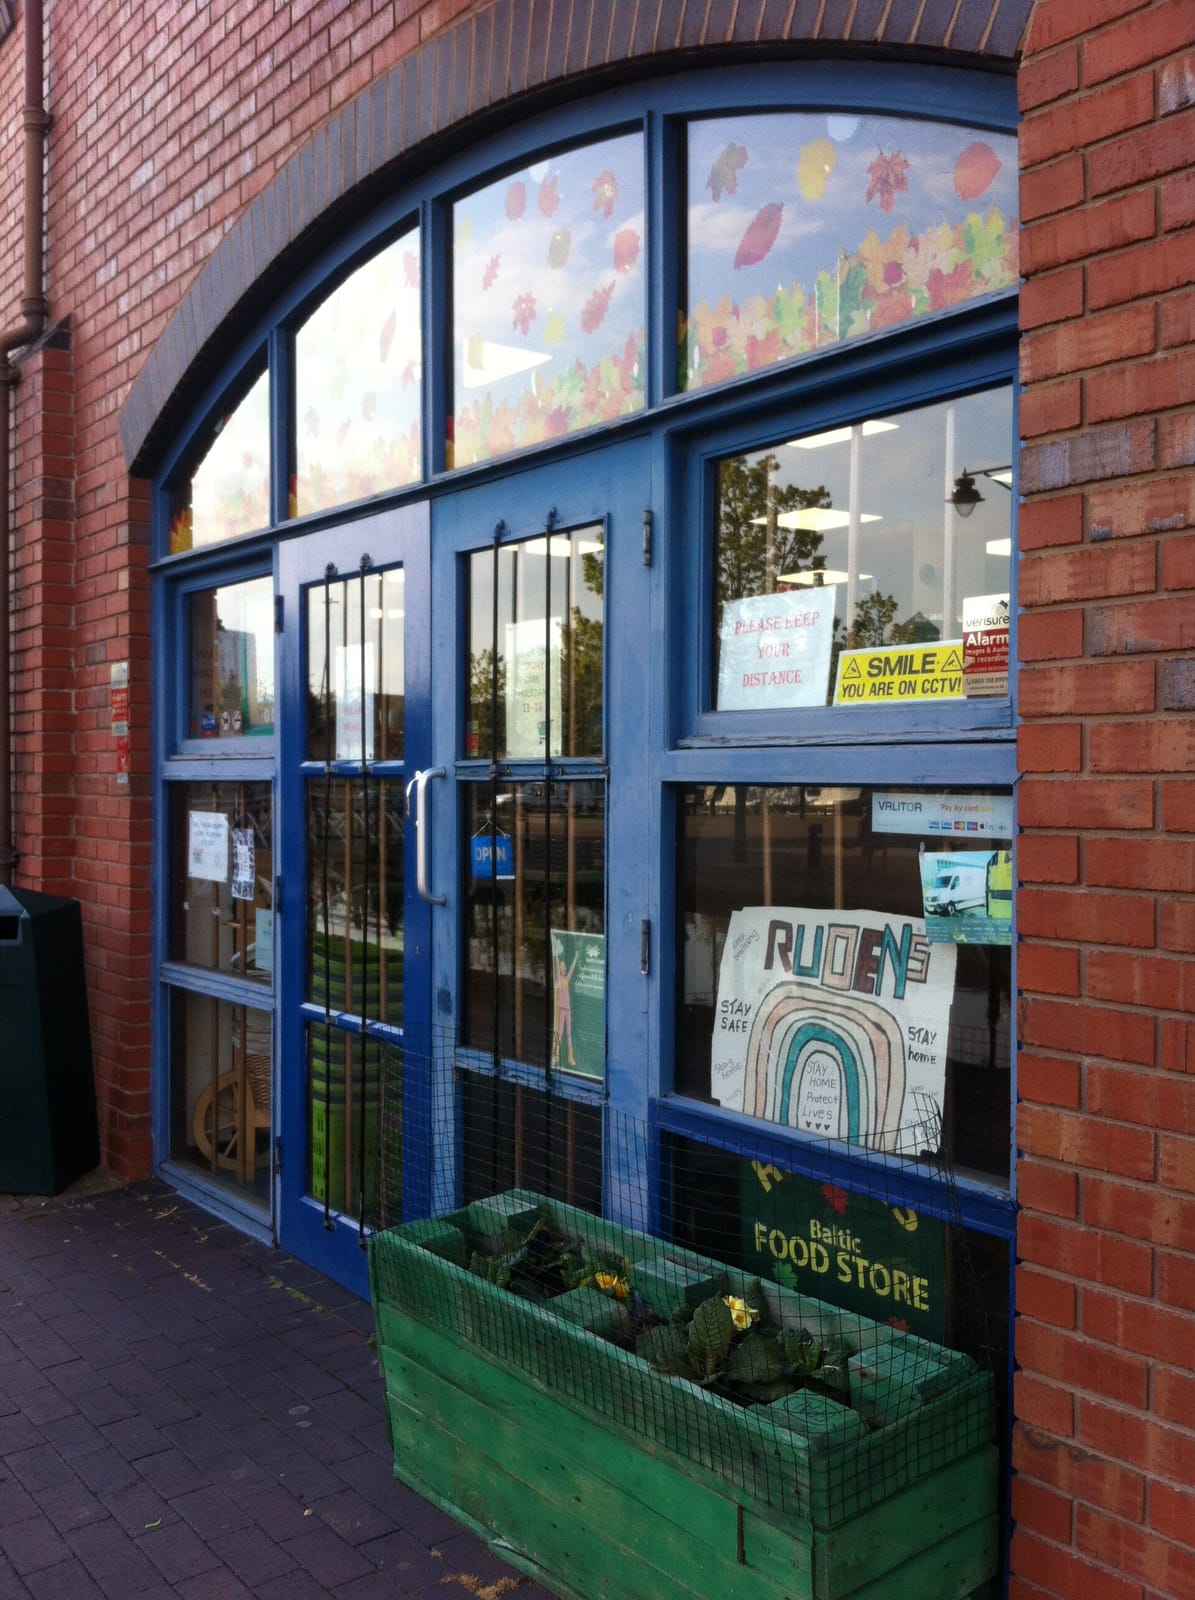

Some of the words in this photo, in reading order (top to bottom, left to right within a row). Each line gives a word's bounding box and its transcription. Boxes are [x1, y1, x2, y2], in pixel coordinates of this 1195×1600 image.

[735, 616, 782, 635] PLEASE
[785, 611, 820, 629] KEEP
[966, 615, 1010, 628] verisure
[966, 631, 1010, 647] Alarm
[757, 643, 790, 659] YOUR
[867, 653, 937, 678] SMILE
[742, 669, 802, 687] DISTANCE
[842, 683, 865, 698] YOU
[868, 681, 894, 697] ARE
[898, 680, 917, 695] ON
[922, 677, 961, 694] CCTV!
[878, 800, 922, 812] VALITOR
[941, 803, 953, 813] Pay
[720, 998, 752, 1017] STAY
[721, 1017, 749, 1033] SAFE
[908, 1026, 937, 1046] STAY
[806, 1060, 829, 1077] STAY
[809, 1075, 837, 1089] HOME
[806, 1091, 839, 1105] Protect
[802, 1104, 833, 1121] Lives
[810, 1219, 861, 1254] Baltic
[754, 1220, 830, 1273] FOOD
[836, 1251, 930, 1311] STORE
